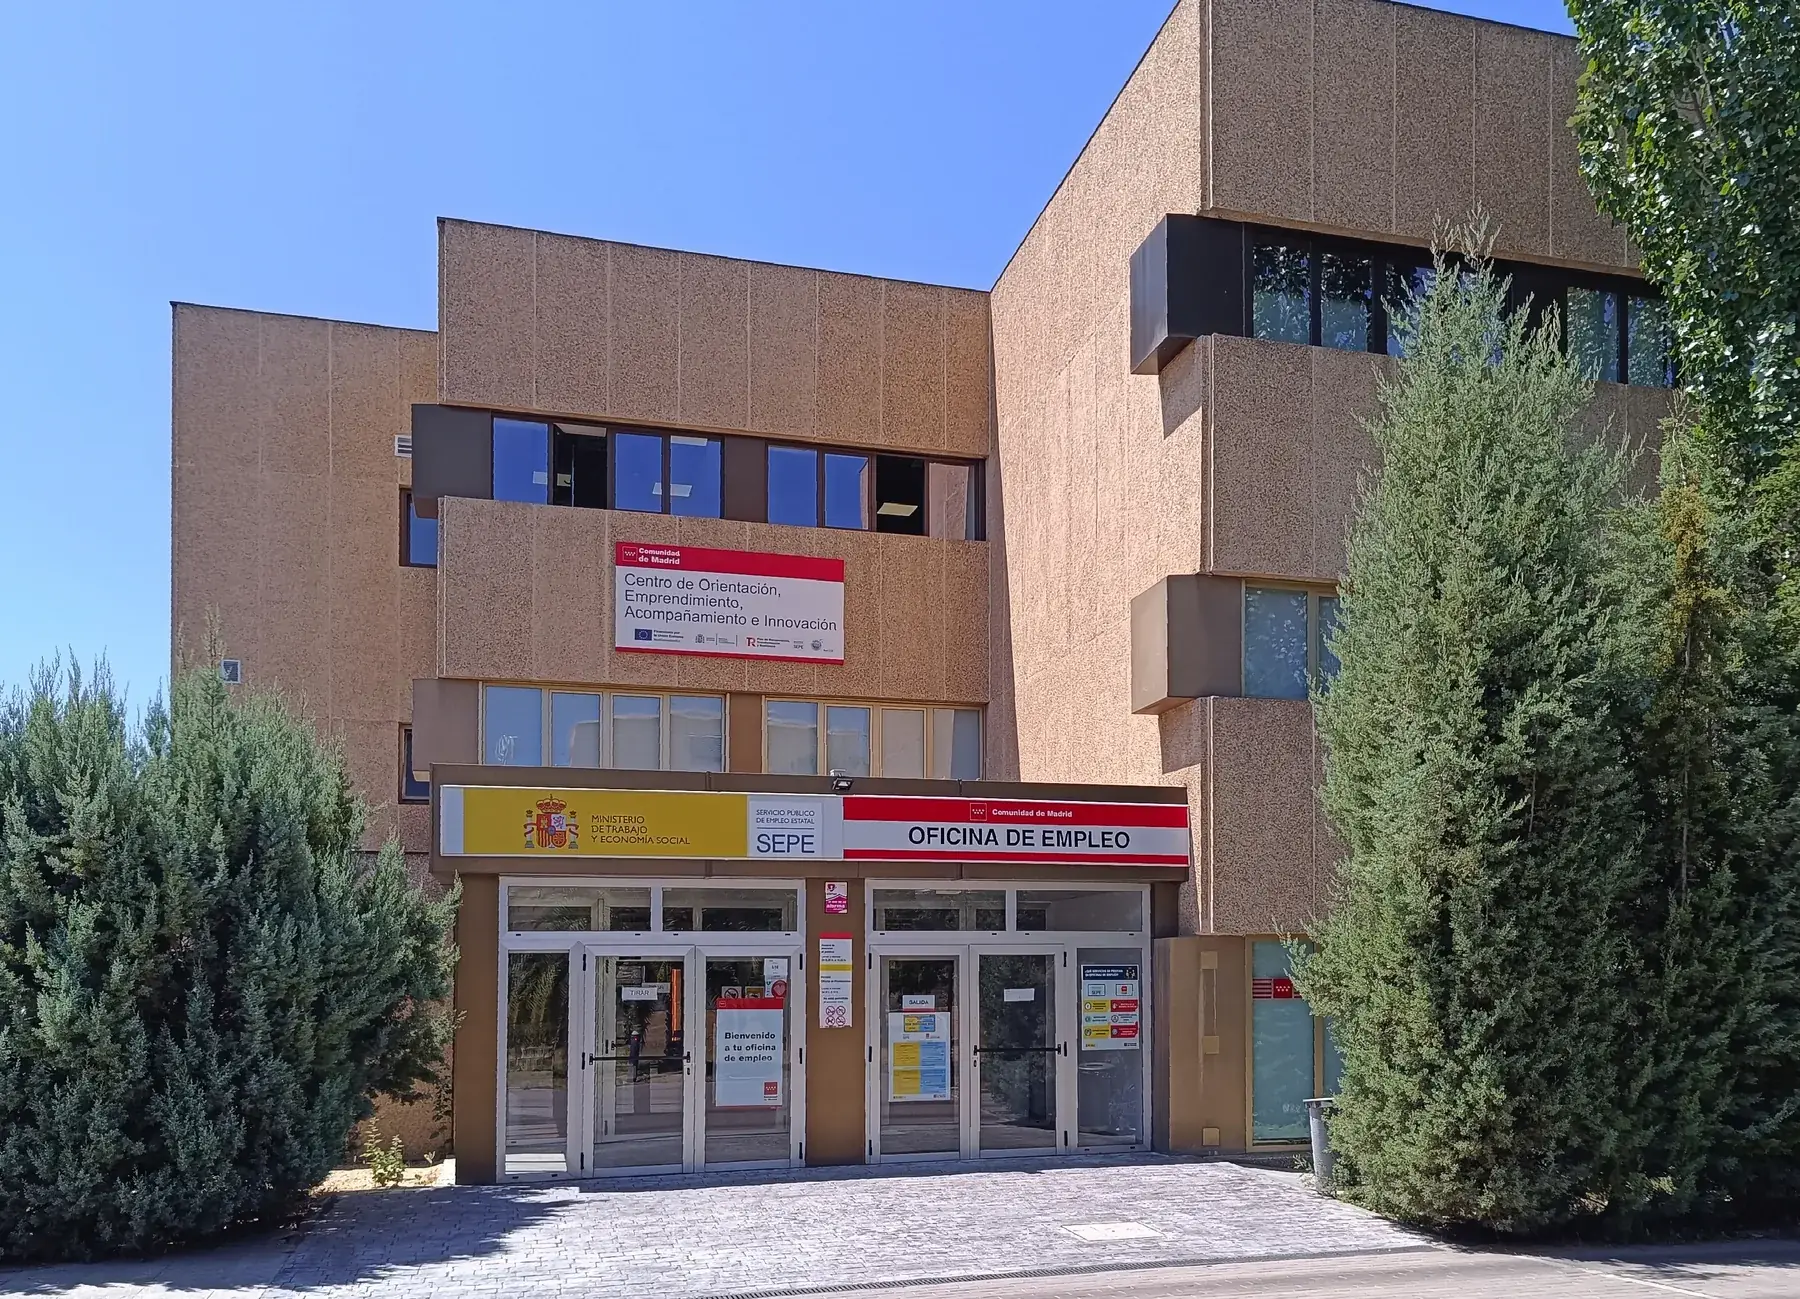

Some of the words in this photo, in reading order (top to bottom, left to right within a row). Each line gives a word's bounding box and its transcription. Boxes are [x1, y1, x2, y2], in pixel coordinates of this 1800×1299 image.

[638, 548, 680, 556] Comunidad
[651, 556, 680, 564] Madrid
[624, 573, 672, 588] Centro
[676, 577, 694, 590] de
[699, 578, 782, 597] Orientación,
[624, 590, 743, 611] Emprendimiento,
[624, 606, 747, 626] Acompañamiento
[752, 616, 760, 626] e
[764, 614, 837, 631] Innovación
[992, 808, 1034, 818] Comunidad
[1036, 809, 1046, 818] de
[1047, 810, 1072, 818] Madrid
[591, 815, 644, 824] MINISTERIO
[600, 834, 654, 844] ECONOMÍA
[908, 826, 999, 847] OFICINA
[1006, 828, 1035, 848] DE
[1042, 829, 1130, 849] EMPLEO
[756, 833, 815, 853] SEPE
[739, 1055, 772, 1063] empleo
